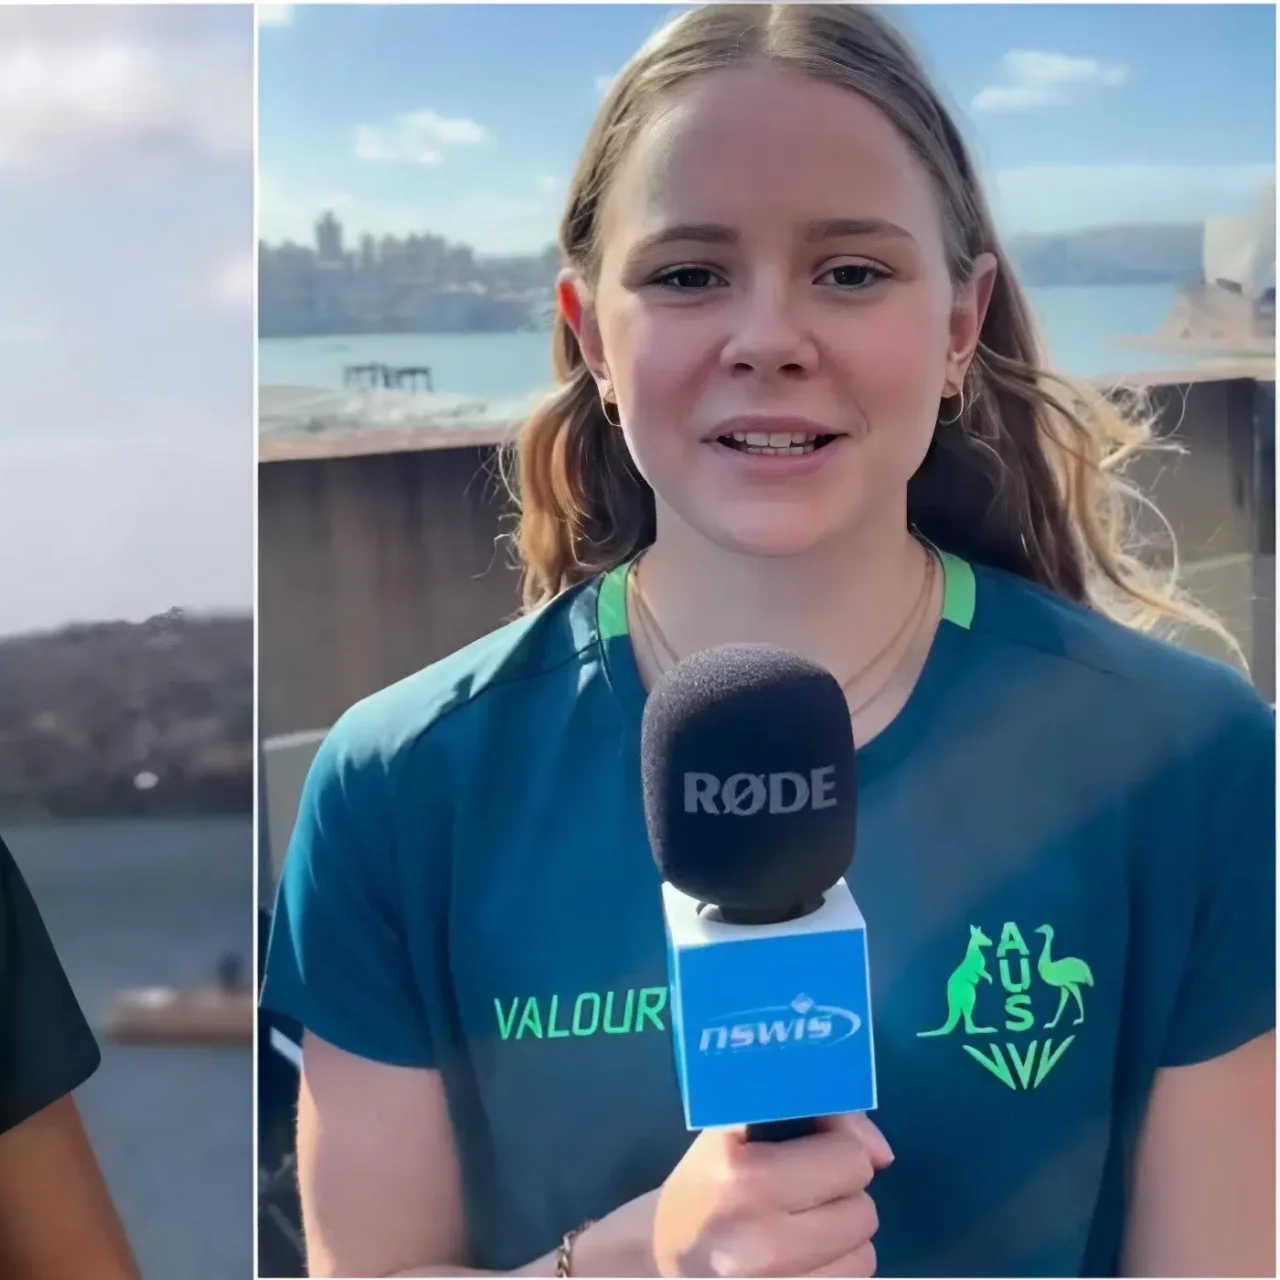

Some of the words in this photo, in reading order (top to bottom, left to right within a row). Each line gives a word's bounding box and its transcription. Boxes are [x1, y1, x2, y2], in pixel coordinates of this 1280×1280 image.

[683, 764, 838, 817] RØDE
[995, 921, 1035, 1032] AUS
[493, 986, 668, 1041] VALOUR
